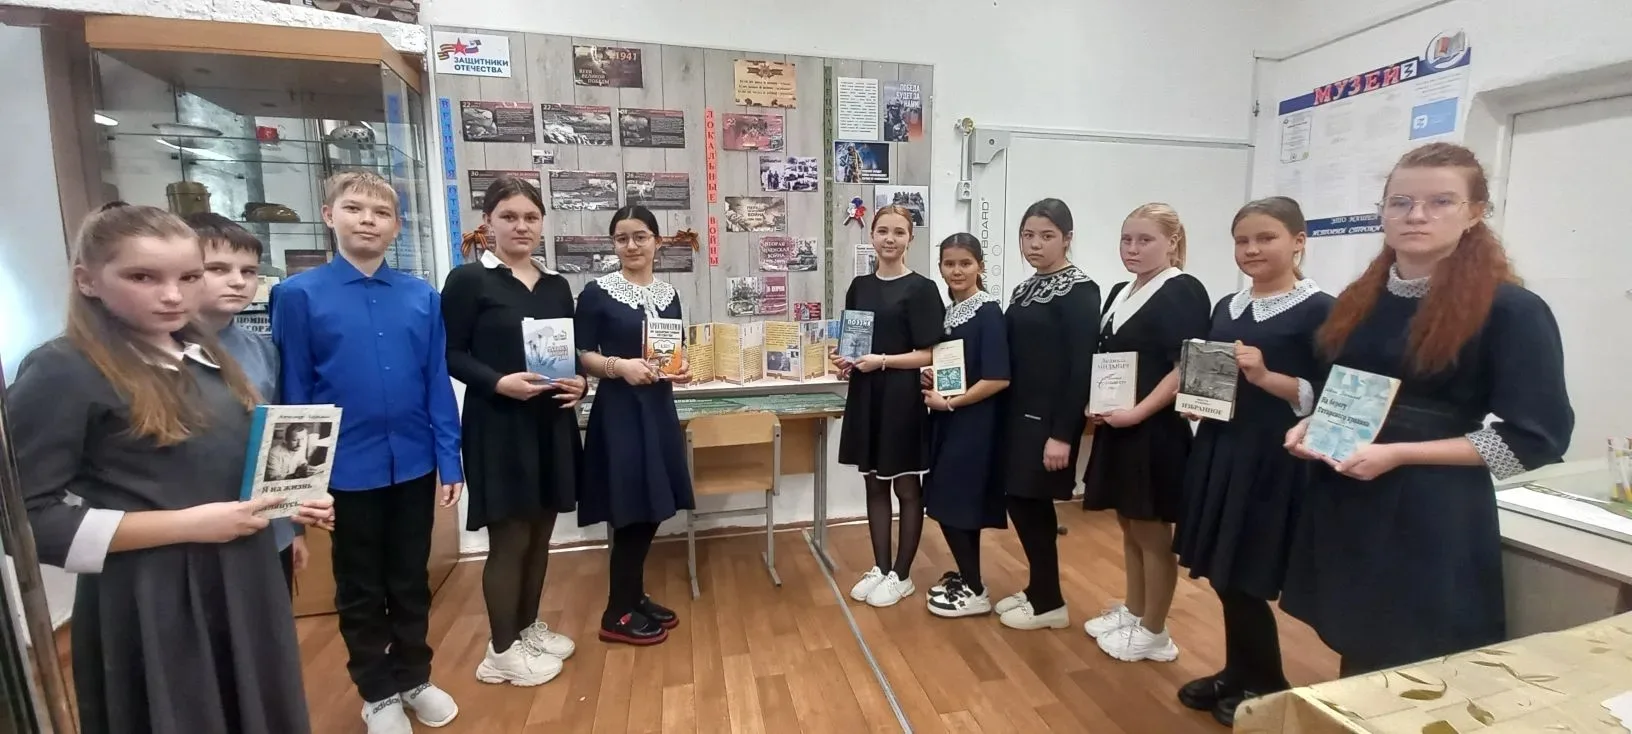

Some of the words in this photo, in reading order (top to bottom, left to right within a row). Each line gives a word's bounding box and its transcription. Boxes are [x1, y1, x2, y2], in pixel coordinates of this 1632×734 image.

[454, 57, 508, 66] ЗАЩИТНИКИ
[615, 52, 637, 61] 1941
[454, 64, 503, 73] ОТЕЧЕСТВА
[1313, 65, 1400, 106] МУЗЕЙ
[896, 91, 911, 100] БУДЕТ
[706, 110, 718, 201] ЛОКАЛЬНЫЕ
[981, 201, 989, 249] BOARD
[709, 217, 719, 265] ВОЙНЫ
[848, 319, 872, 327] ПОЭЗИЯ
[1181, 402, 1223, 416] ИЗБРАННОЕ
[261, 485, 269, 494] Я
[283, 483, 312, 492] жизнь
[410, 682, 432, 700] adida
